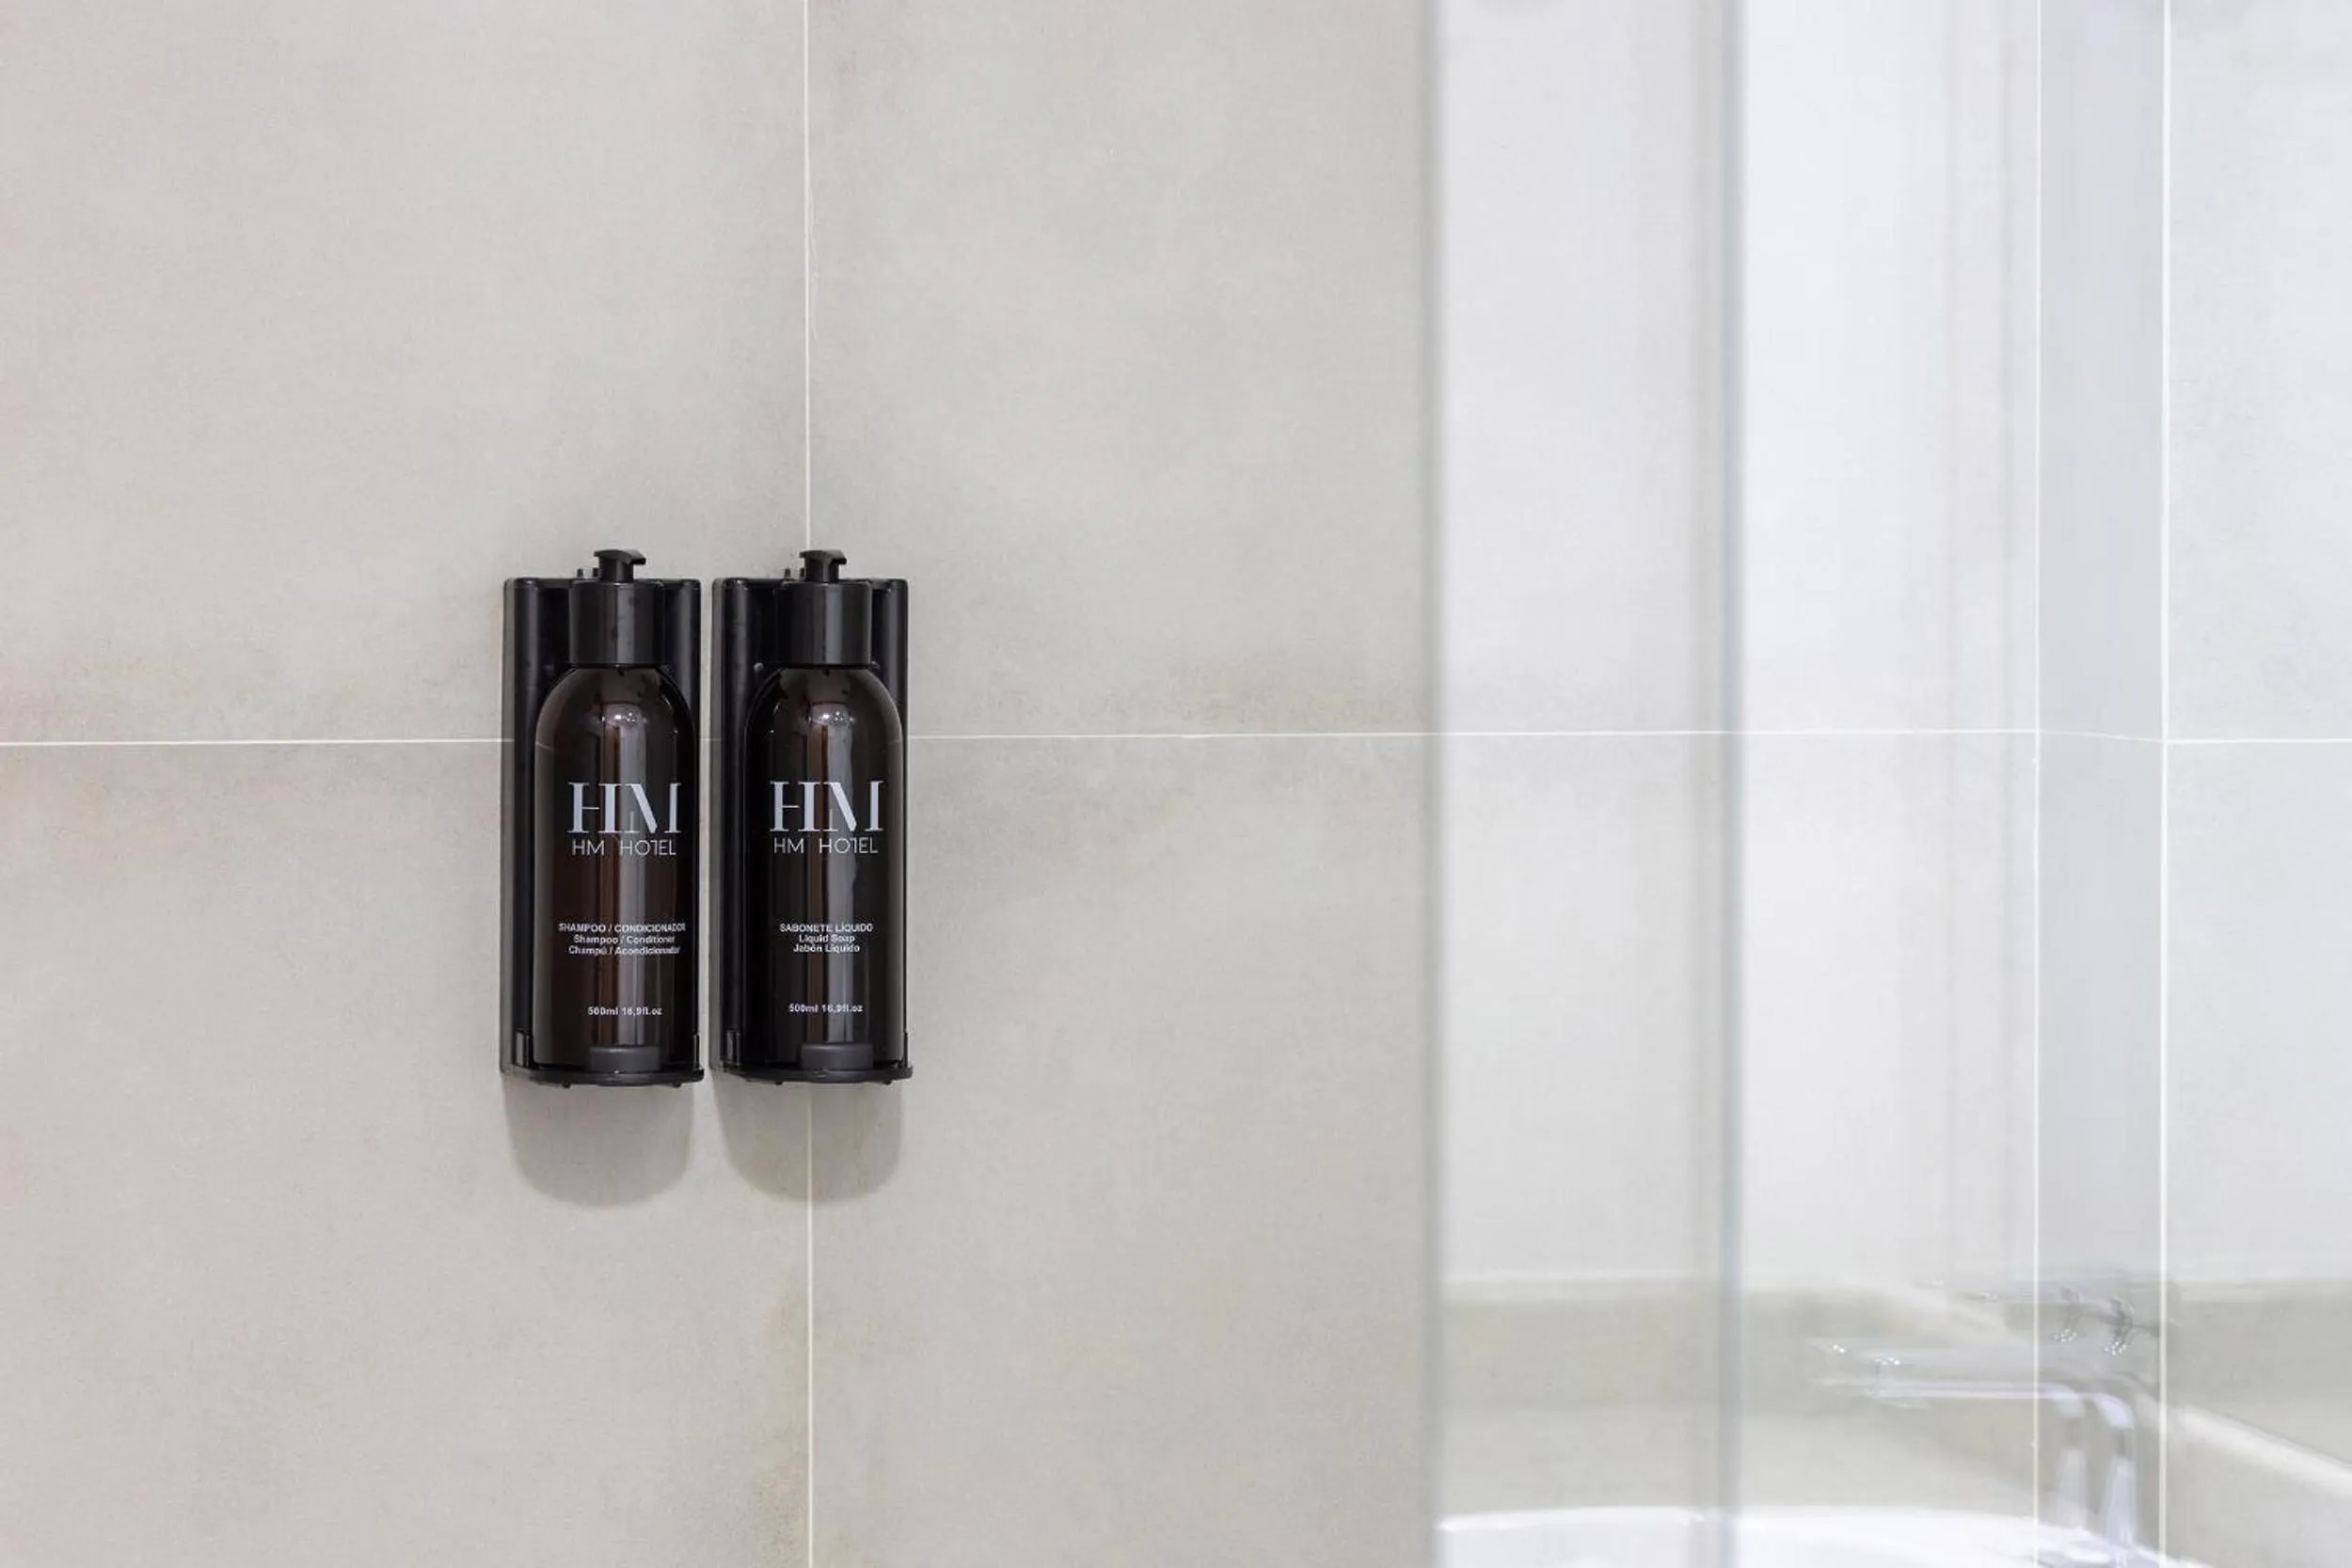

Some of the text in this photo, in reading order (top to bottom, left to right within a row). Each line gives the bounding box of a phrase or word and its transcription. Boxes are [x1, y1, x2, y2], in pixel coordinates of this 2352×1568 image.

[567, 782, 681, 834] HM
[770, 781, 883, 832] HM
[572, 839, 676, 855] HM HOTEL
[774, 837, 879, 853] HM HOTEL
[558, 923, 606, 932] SHAMPOO
[613, 923, 686, 932] CONDICIONADOR
[779, 923, 833, 932] SABONETE
[573, 934, 618, 944] Shampoo
[799, 934, 855, 943] Liquid Soap
[587, 1006, 619, 1016] 500ml
